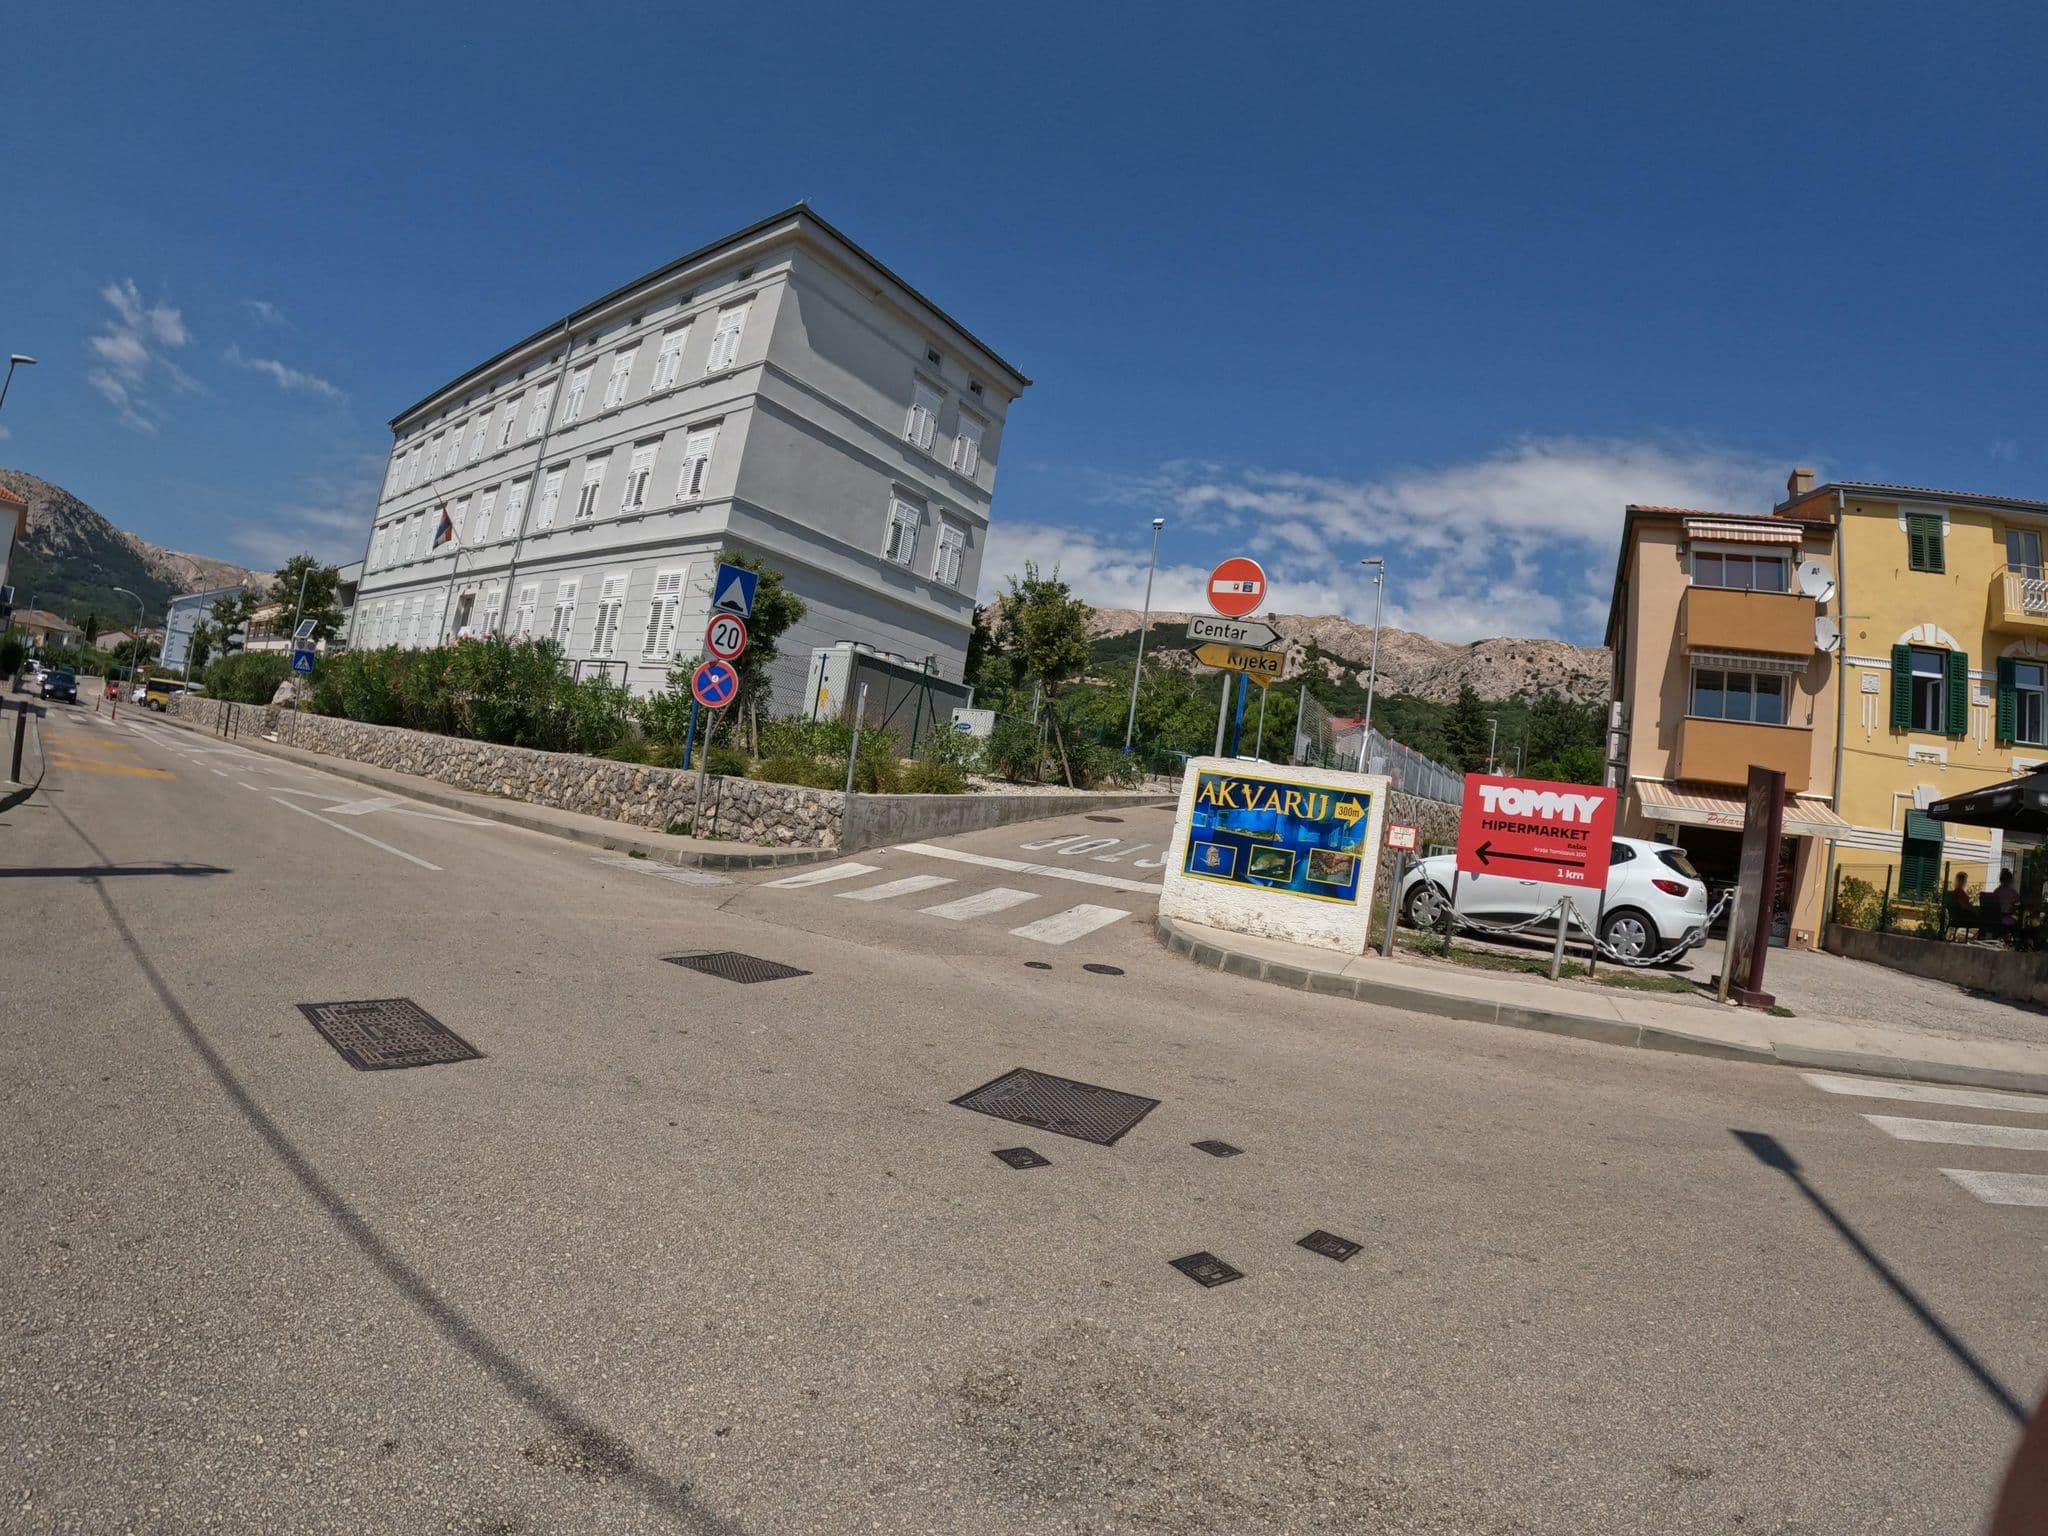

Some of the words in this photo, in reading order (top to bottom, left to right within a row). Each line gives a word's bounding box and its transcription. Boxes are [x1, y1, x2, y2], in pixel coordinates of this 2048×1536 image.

[715, 623, 740, 650] 20
[1194, 620, 1248, 640] Centar
[1198, 780, 1330, 821] AKVARIJ
[1479, 784, 1605, 824] TOMMY
[1338, 806, 1360, 818] 300m
[1482, 819, 1590, 841] HIPERMARKET
[1557, 868, 1564, 878] 1
[1566, 869, 1584, 880] km
